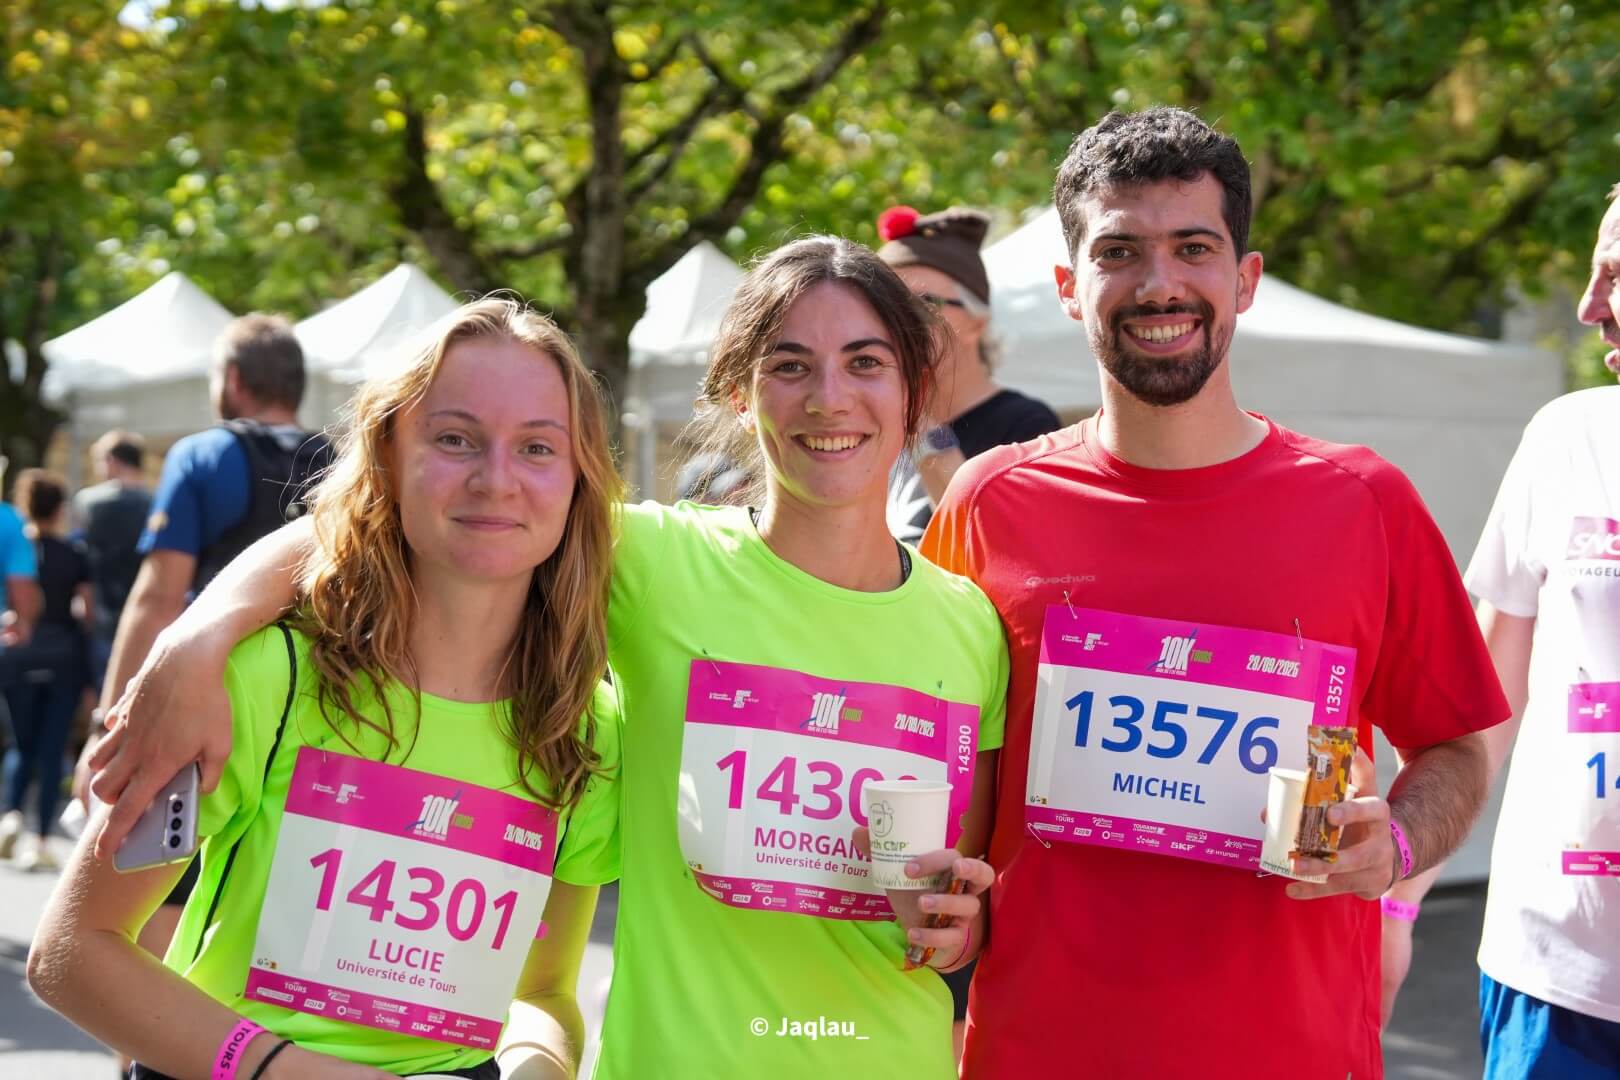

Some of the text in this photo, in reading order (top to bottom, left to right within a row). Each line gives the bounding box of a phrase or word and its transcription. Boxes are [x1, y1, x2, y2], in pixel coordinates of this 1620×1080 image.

[1159, 635, 1196, 670] 10K
[1325, 665, 1346, 714] 13576
[812, 692, 846, 730] 10K
[958, 725, 972, 774] 14300
[1065, 690, 1281, 776] 13576
[716, 750, 919, 828] 1430
[1112, 772, 1206, 804] MICHEL
[422, 794, 459, 834] 10K
[754, 827, 872, 863] MORGAN
[756, 852, 868, 878] Université de Tours
[310, 848, 519, 950] 14301
[368, 939, 445, 973] LUCIE
[336, 958, 457, 994] Université de Tours
[220, 1027, 252, 1070] TOURS
